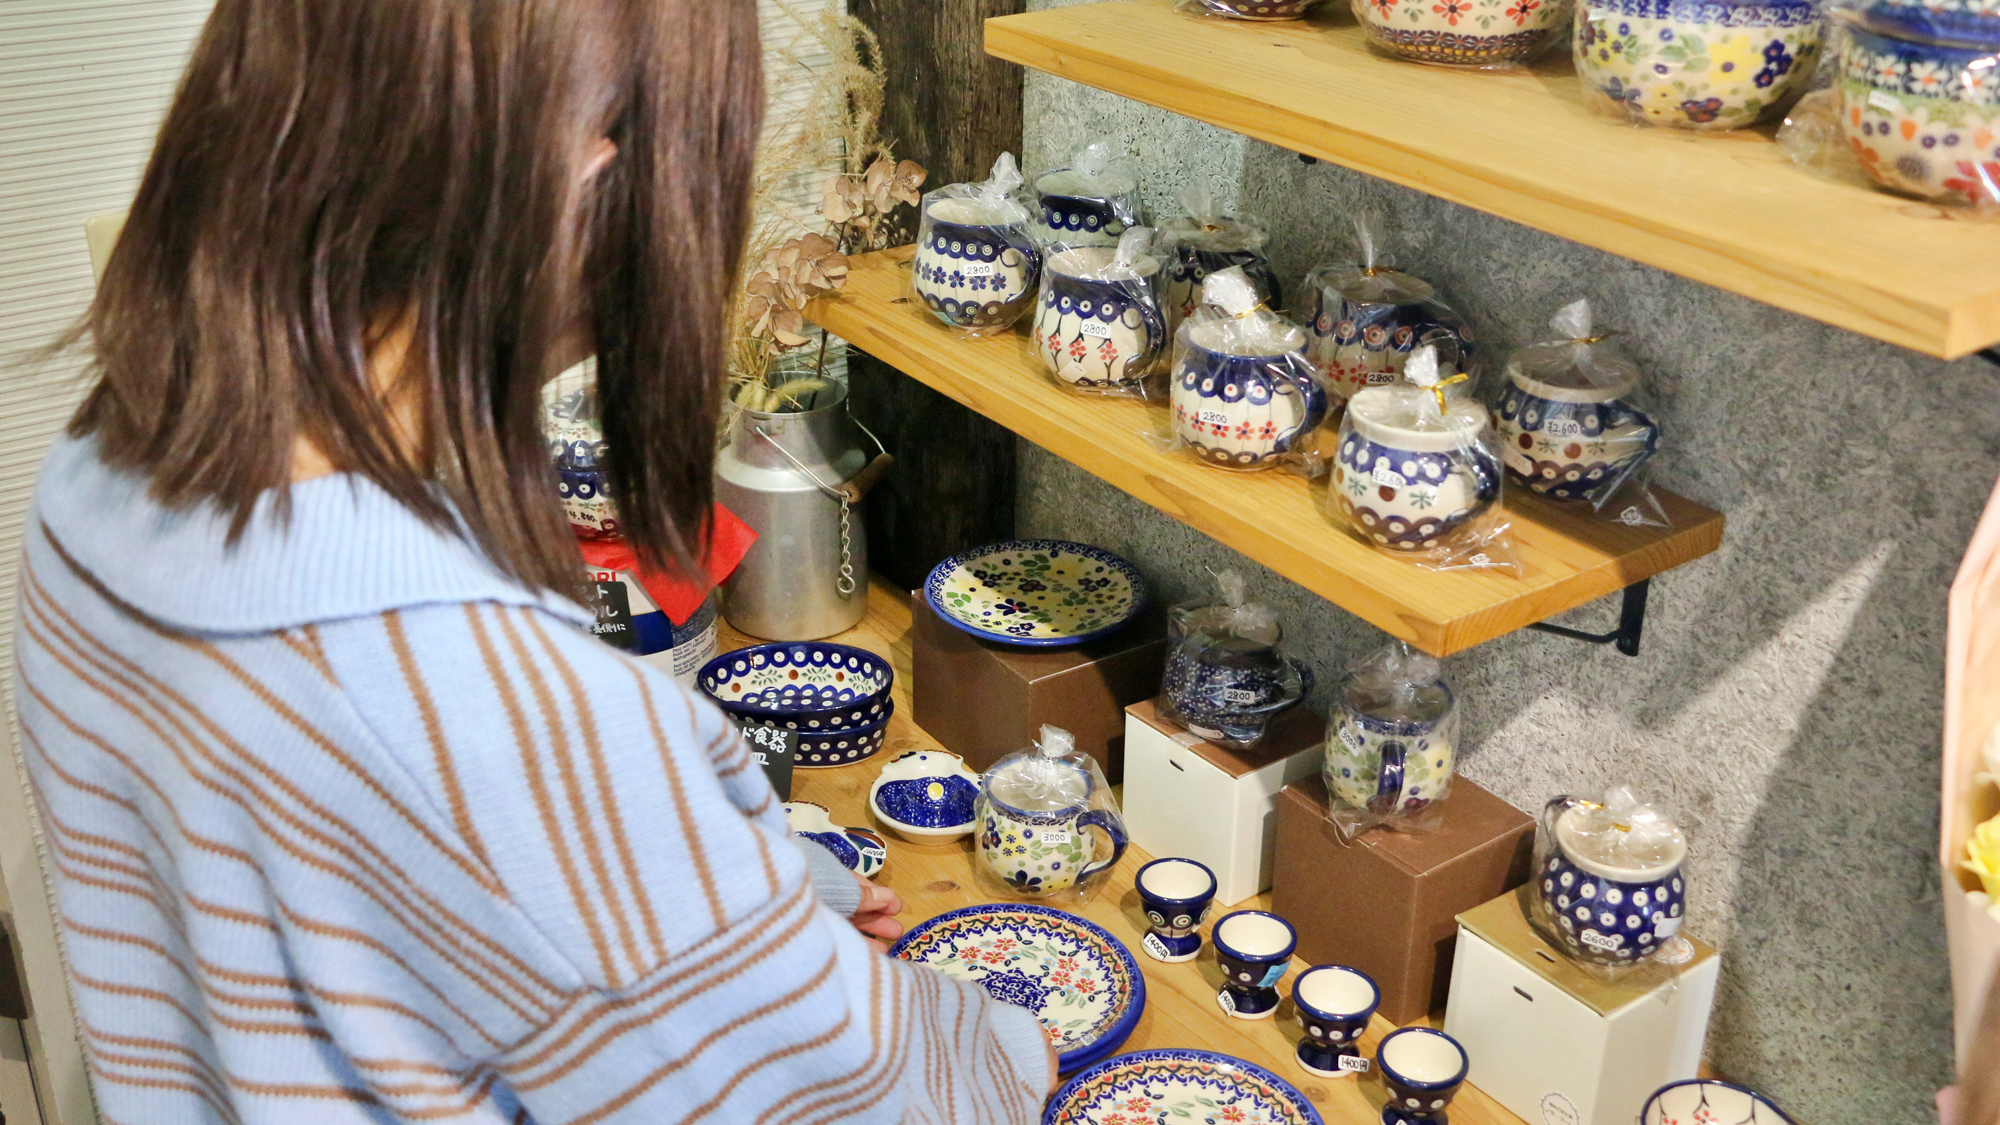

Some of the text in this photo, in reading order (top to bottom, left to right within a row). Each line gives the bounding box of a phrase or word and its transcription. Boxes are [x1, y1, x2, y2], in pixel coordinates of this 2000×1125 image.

[967, 266, 990, 275] 2800
[1084, 324, 1107, 335] 2800
[1368, 373, 1394, 383] 2800
[1203, 411, 1227, 423] 2800
[1227, 691, 1250, 700] 2800
[735, 726, 787, 753] ド食器
[1341, 730, 1356, 749] 3000
[1044, 833, 1065, 841] 3000
[1583, 932, 1614, 948] 2600
[1341, 1057, 1367, 1071] 1400円
